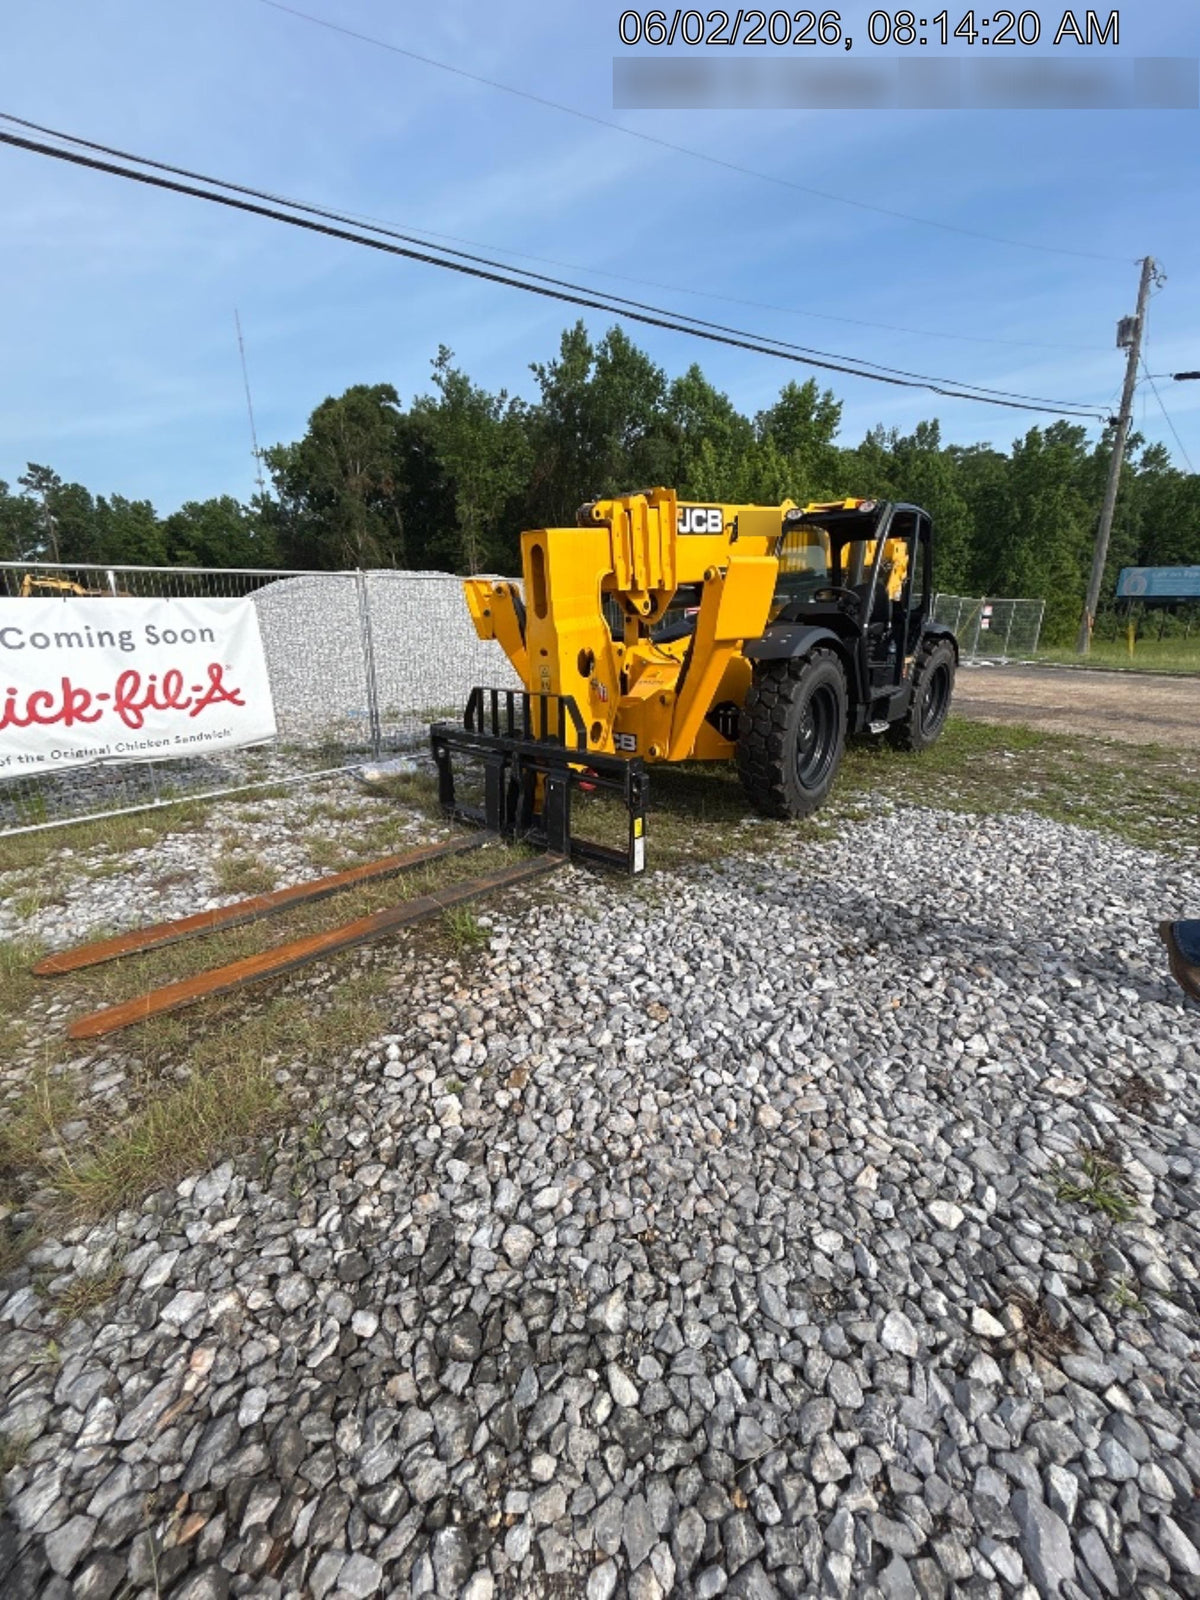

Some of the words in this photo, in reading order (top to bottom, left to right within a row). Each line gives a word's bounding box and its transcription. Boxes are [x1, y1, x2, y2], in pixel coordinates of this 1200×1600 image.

[678, 508, 723, 533] JCB
[0, 625, 136, 651] Coming
[145, 624, 215, 645] Soon
[0, 662, 246, 729] ick-fil-A
[17, 752, 45, 763] the
[51, 743, 111, 760] Original
[115, 738, 170, 752] Chicken
[174, 728, 232, 744] Sandwich
